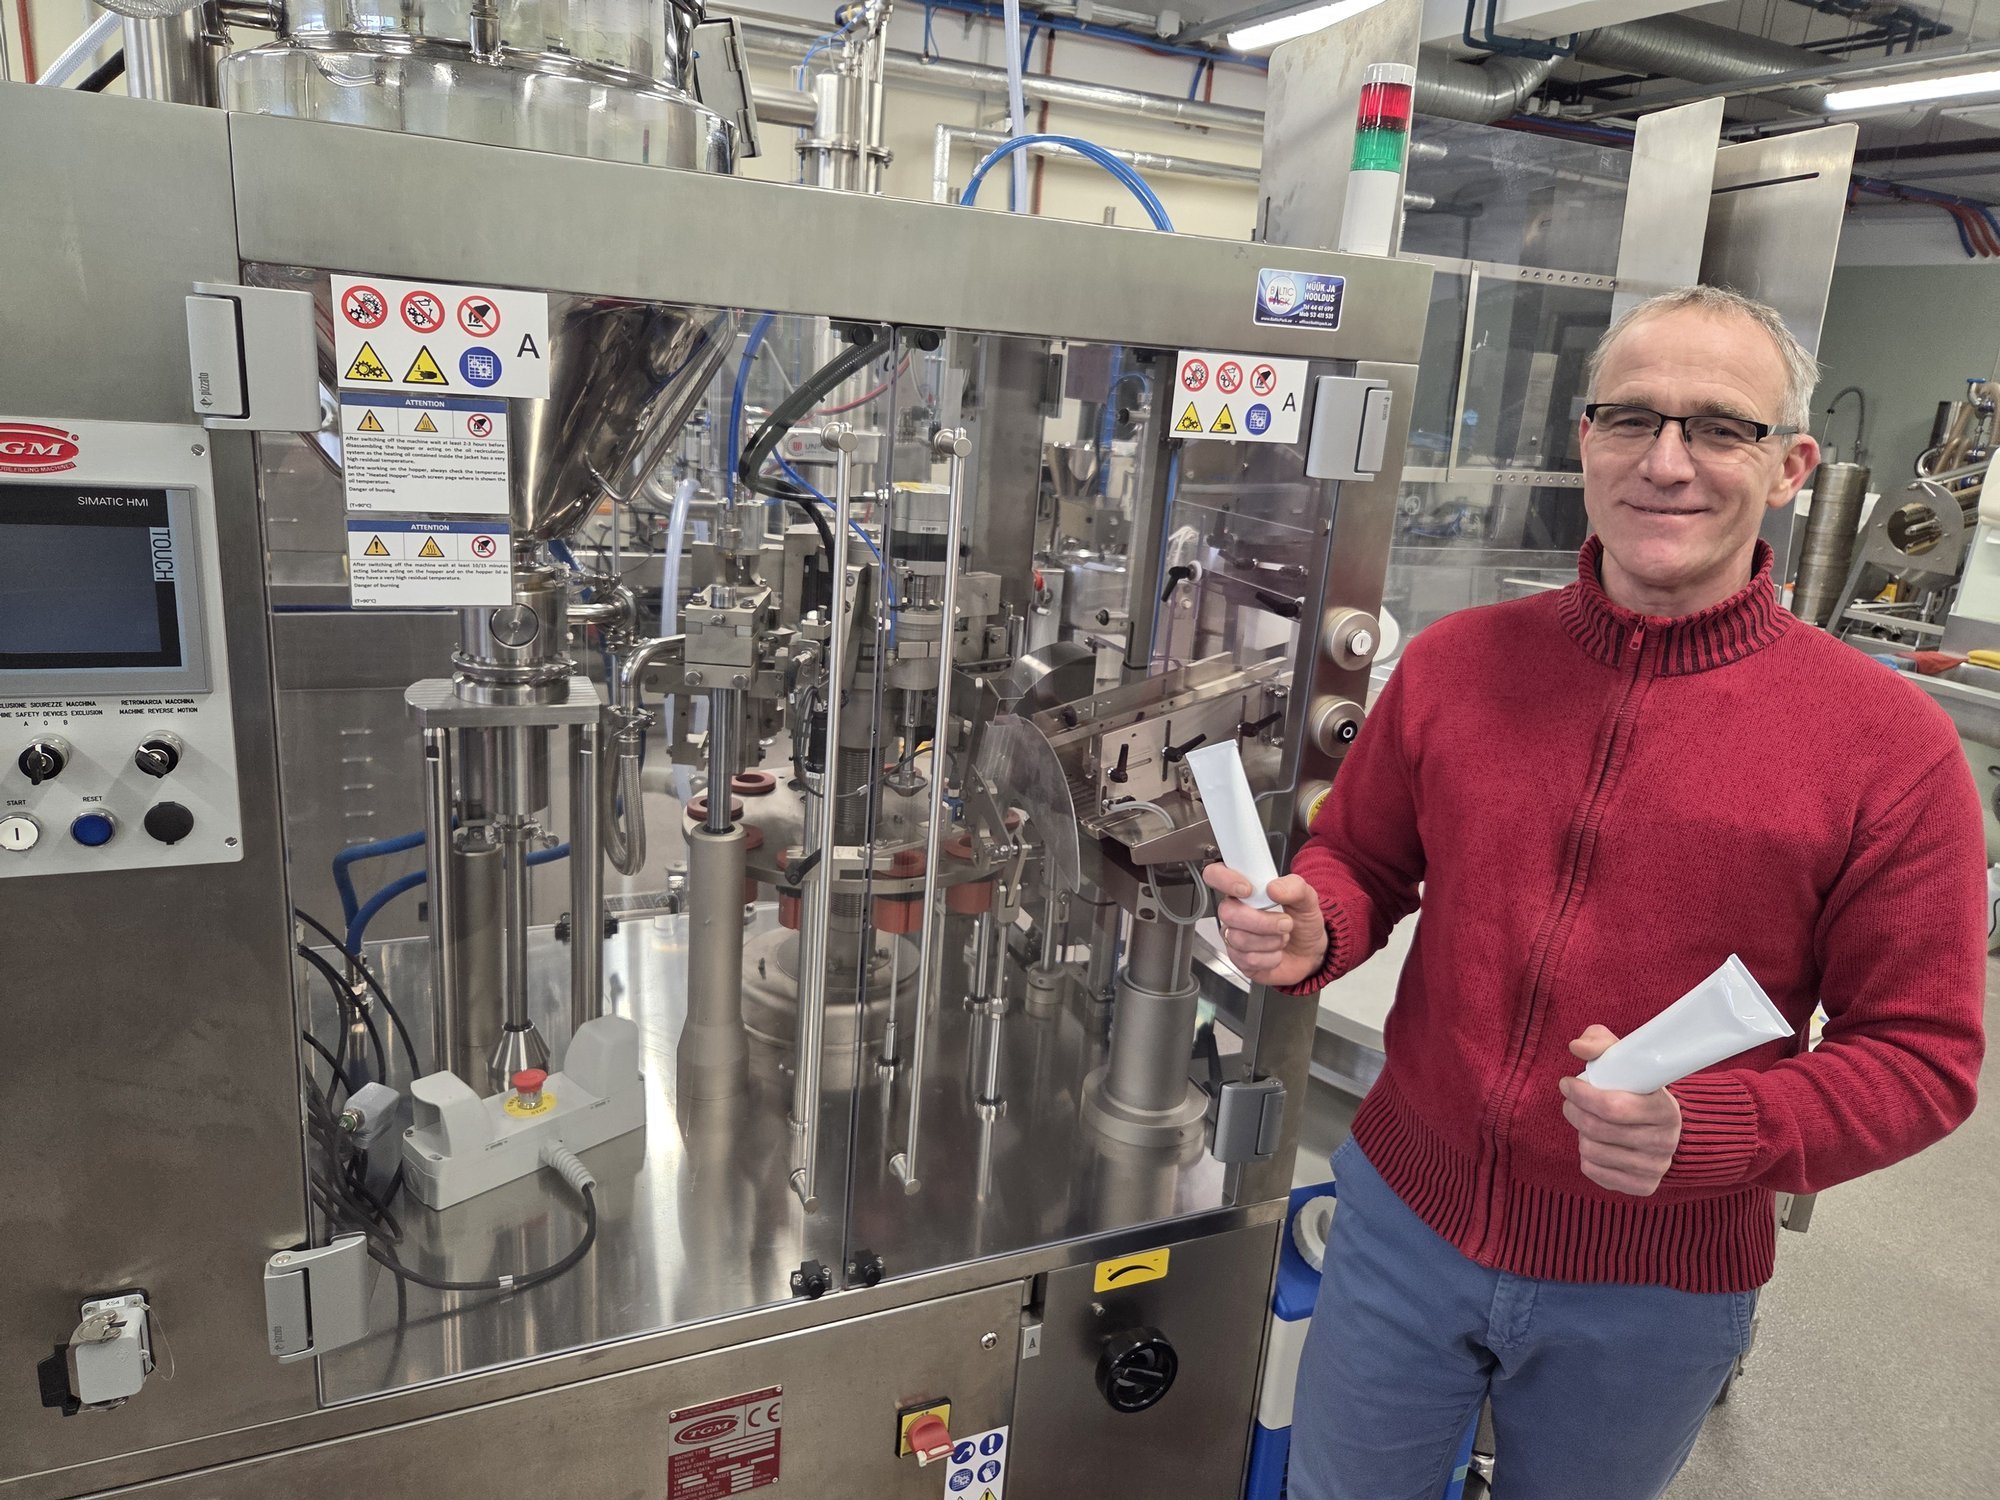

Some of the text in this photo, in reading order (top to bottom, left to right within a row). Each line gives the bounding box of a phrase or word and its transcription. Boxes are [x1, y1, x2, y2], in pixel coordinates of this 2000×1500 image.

[1306, 282, 1324, 291] MÜÜK
[1305, 292, 1335, 302] HOOLDUS
[517, 334, 540, 358] A
[198, 372, 212, 395] pizzato
[405, 399, 445, 408] ATTENTION
[1282, 393, 1296, 412] A
[41, 463, 74, 472] MACHINES
[78, 496, 148, 507] SIMATIC HMI
[151, 529, 174, 581] TOUCH
[1029, 1337, 1036, 1348] A
[689, 1422, 729, 1437] TGM
[694, 1456, 726, 1467] CONSTRUCTION
[674, 1470, 697, 1478] TECHNICAL
